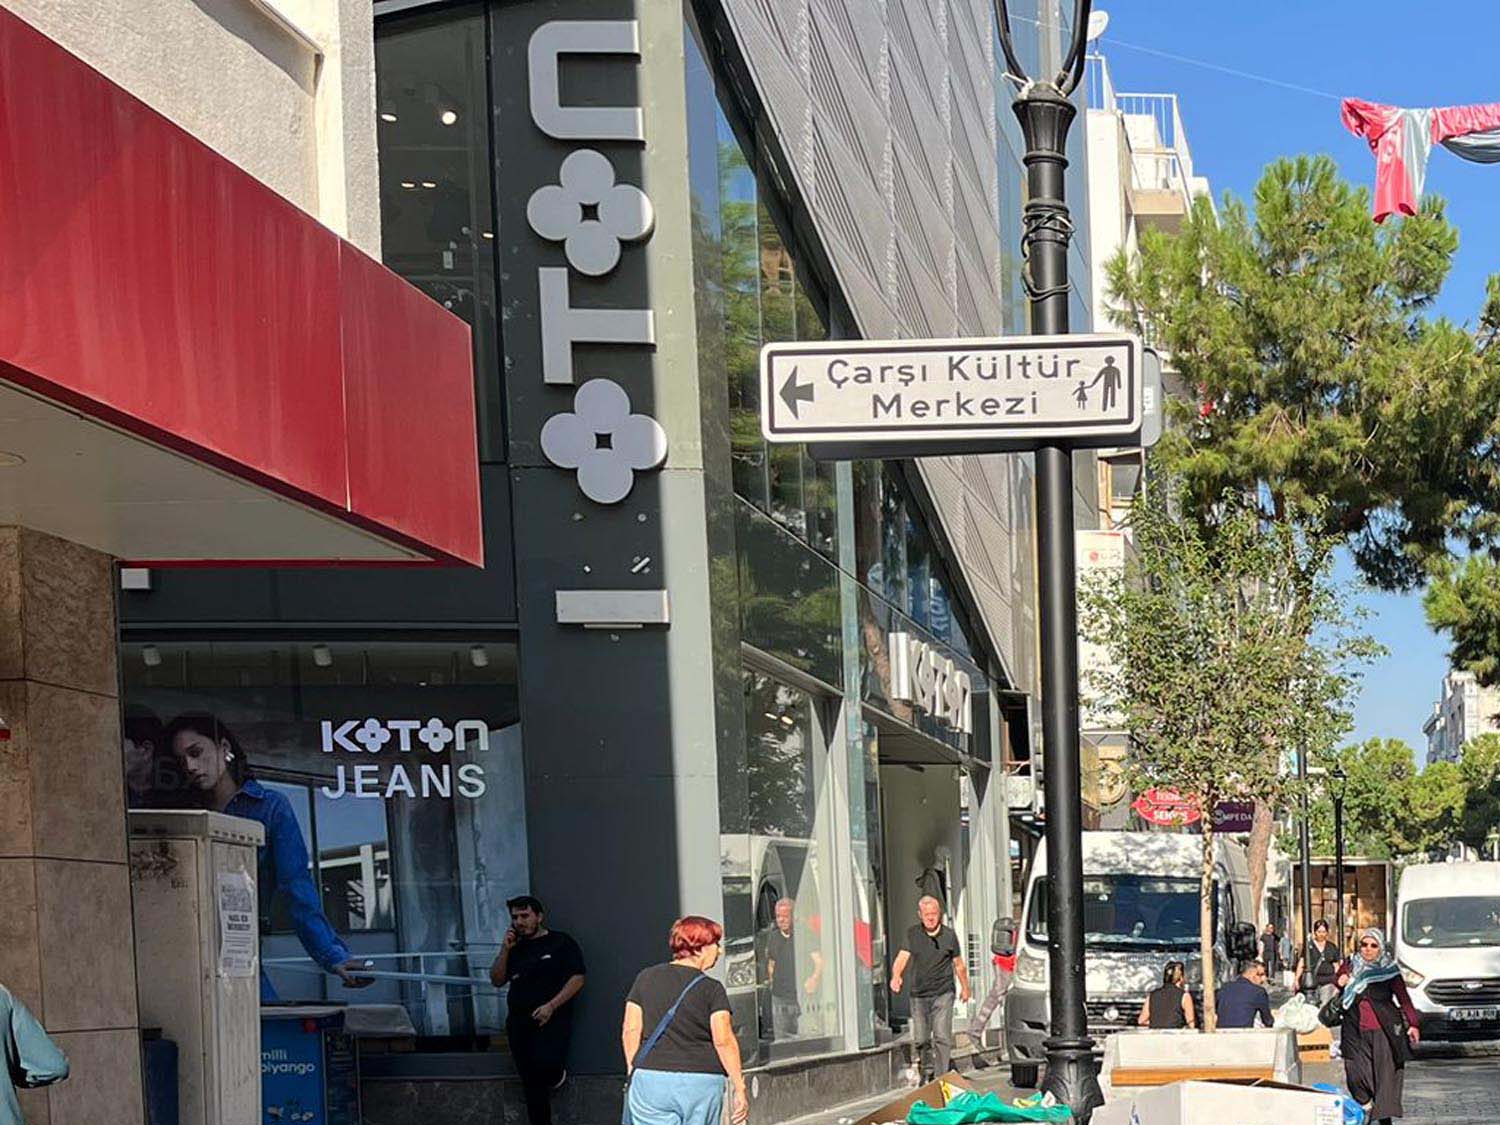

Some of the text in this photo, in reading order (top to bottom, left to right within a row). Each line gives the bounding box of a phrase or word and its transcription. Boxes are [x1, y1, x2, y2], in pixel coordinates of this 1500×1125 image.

[827, 353, 1082, 390] Çarşı Kültür
[873, 391, 1038, 418] Merkezi
[321, 717, 489, 753] KOTON
[322, 764, 487, 799] JEANS
